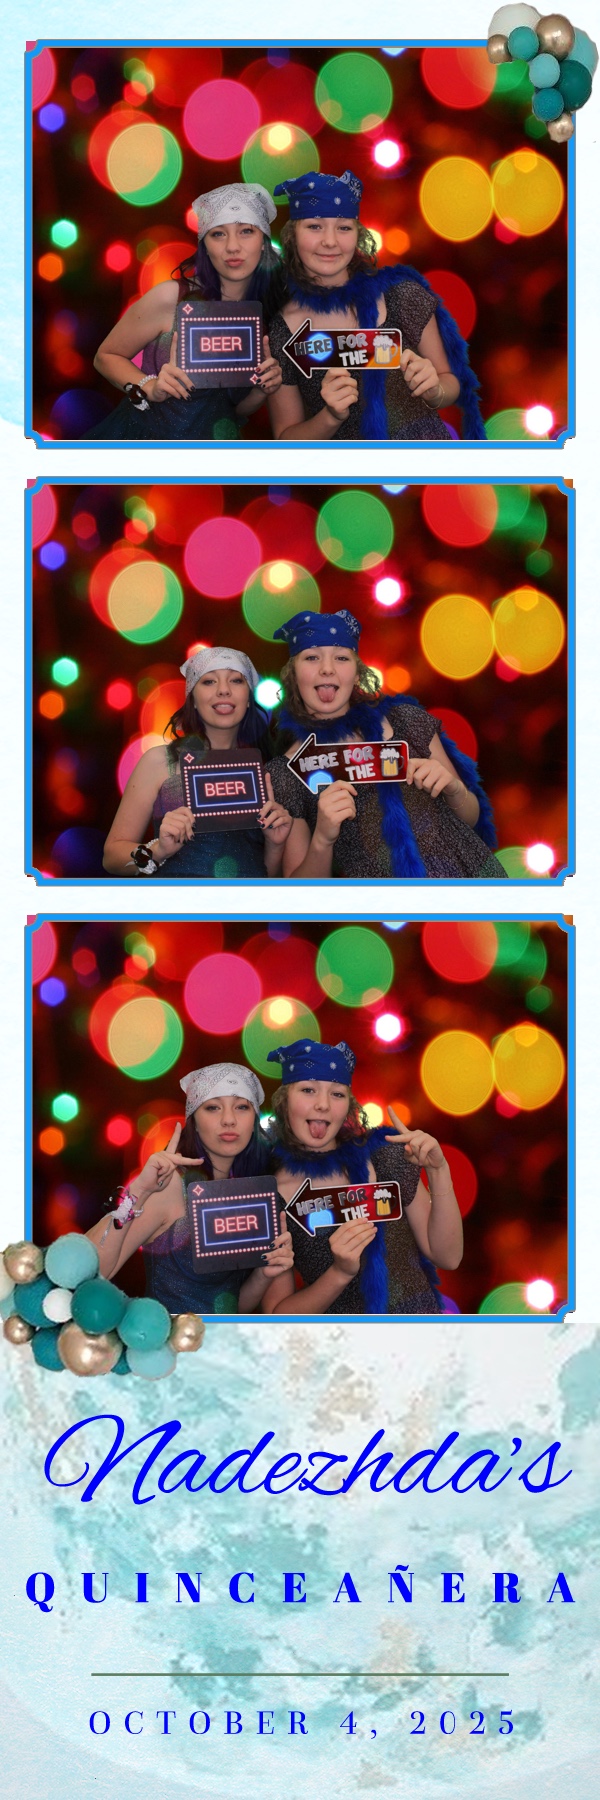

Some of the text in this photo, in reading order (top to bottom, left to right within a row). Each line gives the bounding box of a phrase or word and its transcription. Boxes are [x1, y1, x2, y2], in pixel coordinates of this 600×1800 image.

[200, 336, 243, 352] BEER
[294, 332, 368, 357] HERE FOR
[339, 349, 369, 367] THE
[299, 746, 375, 773] HERE FOR
[345, 762, 376, 781] THE
[204, 780, 247, 798] BEER
[296, 1188, 369, 1217] HERE FOR
[341, 1203, 370, 1222] THE
[214, 1215, 259, 1234] BEER
